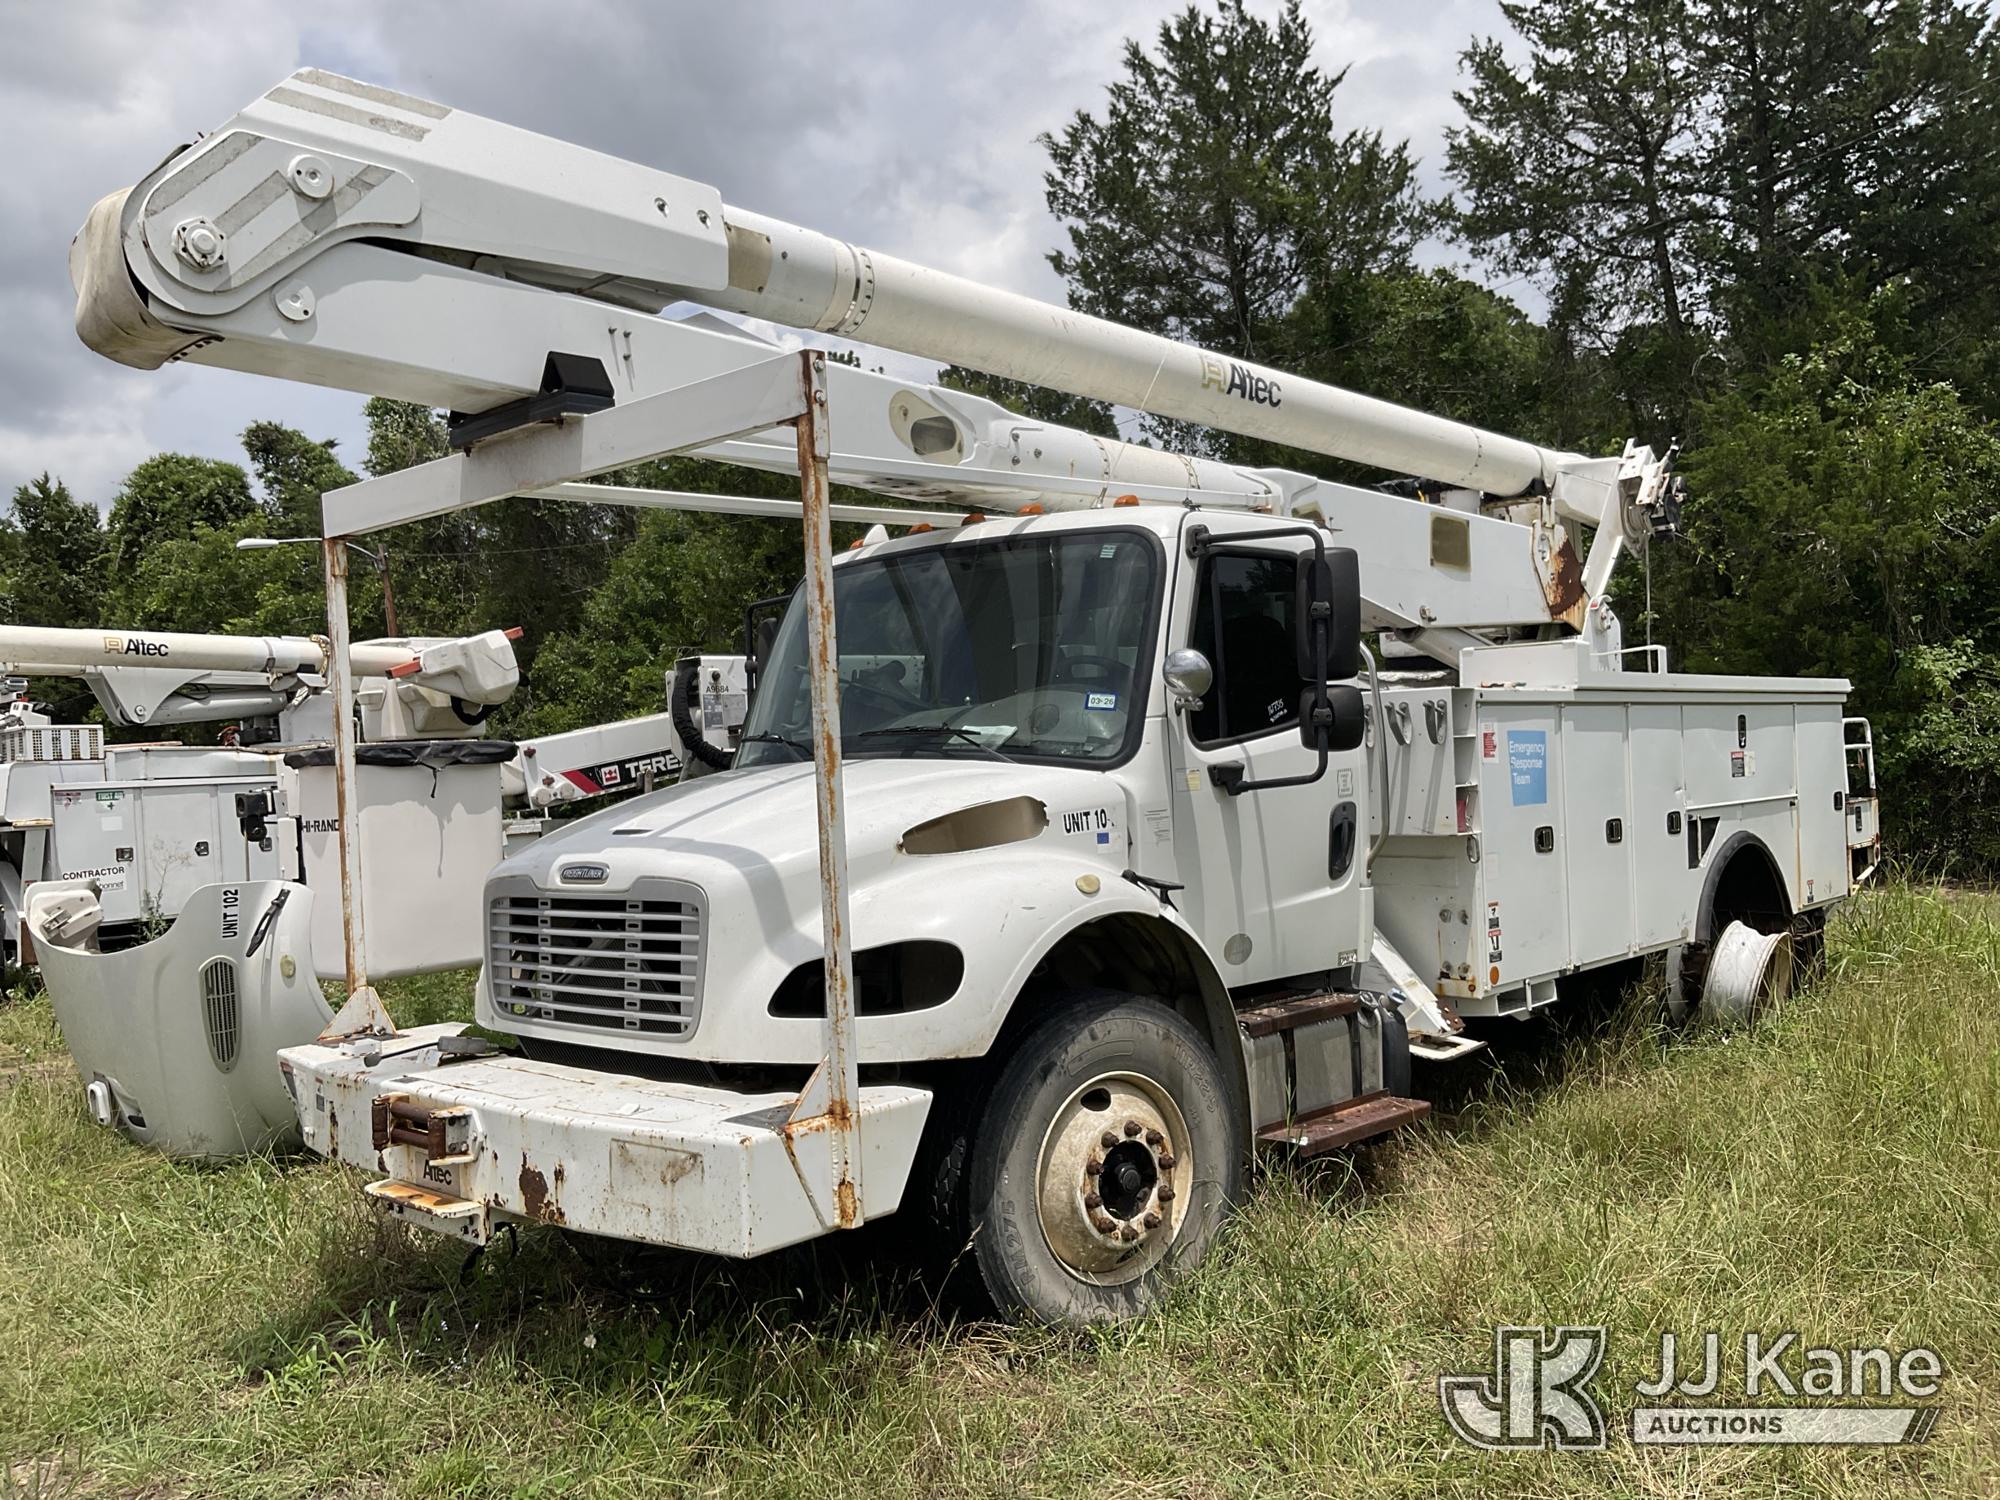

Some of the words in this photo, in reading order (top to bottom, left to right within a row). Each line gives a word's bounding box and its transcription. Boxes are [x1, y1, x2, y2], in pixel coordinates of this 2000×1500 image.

[1226, 363, 1282, 408] Altec
[124, 638, 169, 657] Altec
[1508, 740, 1545, 756] Emergency
[625, 754, 683, 778] TERE
[1509, 756, 1543, 771] Response
[1511, 772, 1531, 785] Team
[1063, 810, 1091, 834] UNIT
[62, 866, 125, 881] CONTRACTOR
[562, 866, 604, 880] FREIGHTLINER
[223, 889, 238, 909] 102
[222, 912, 238, 938] UNIT
